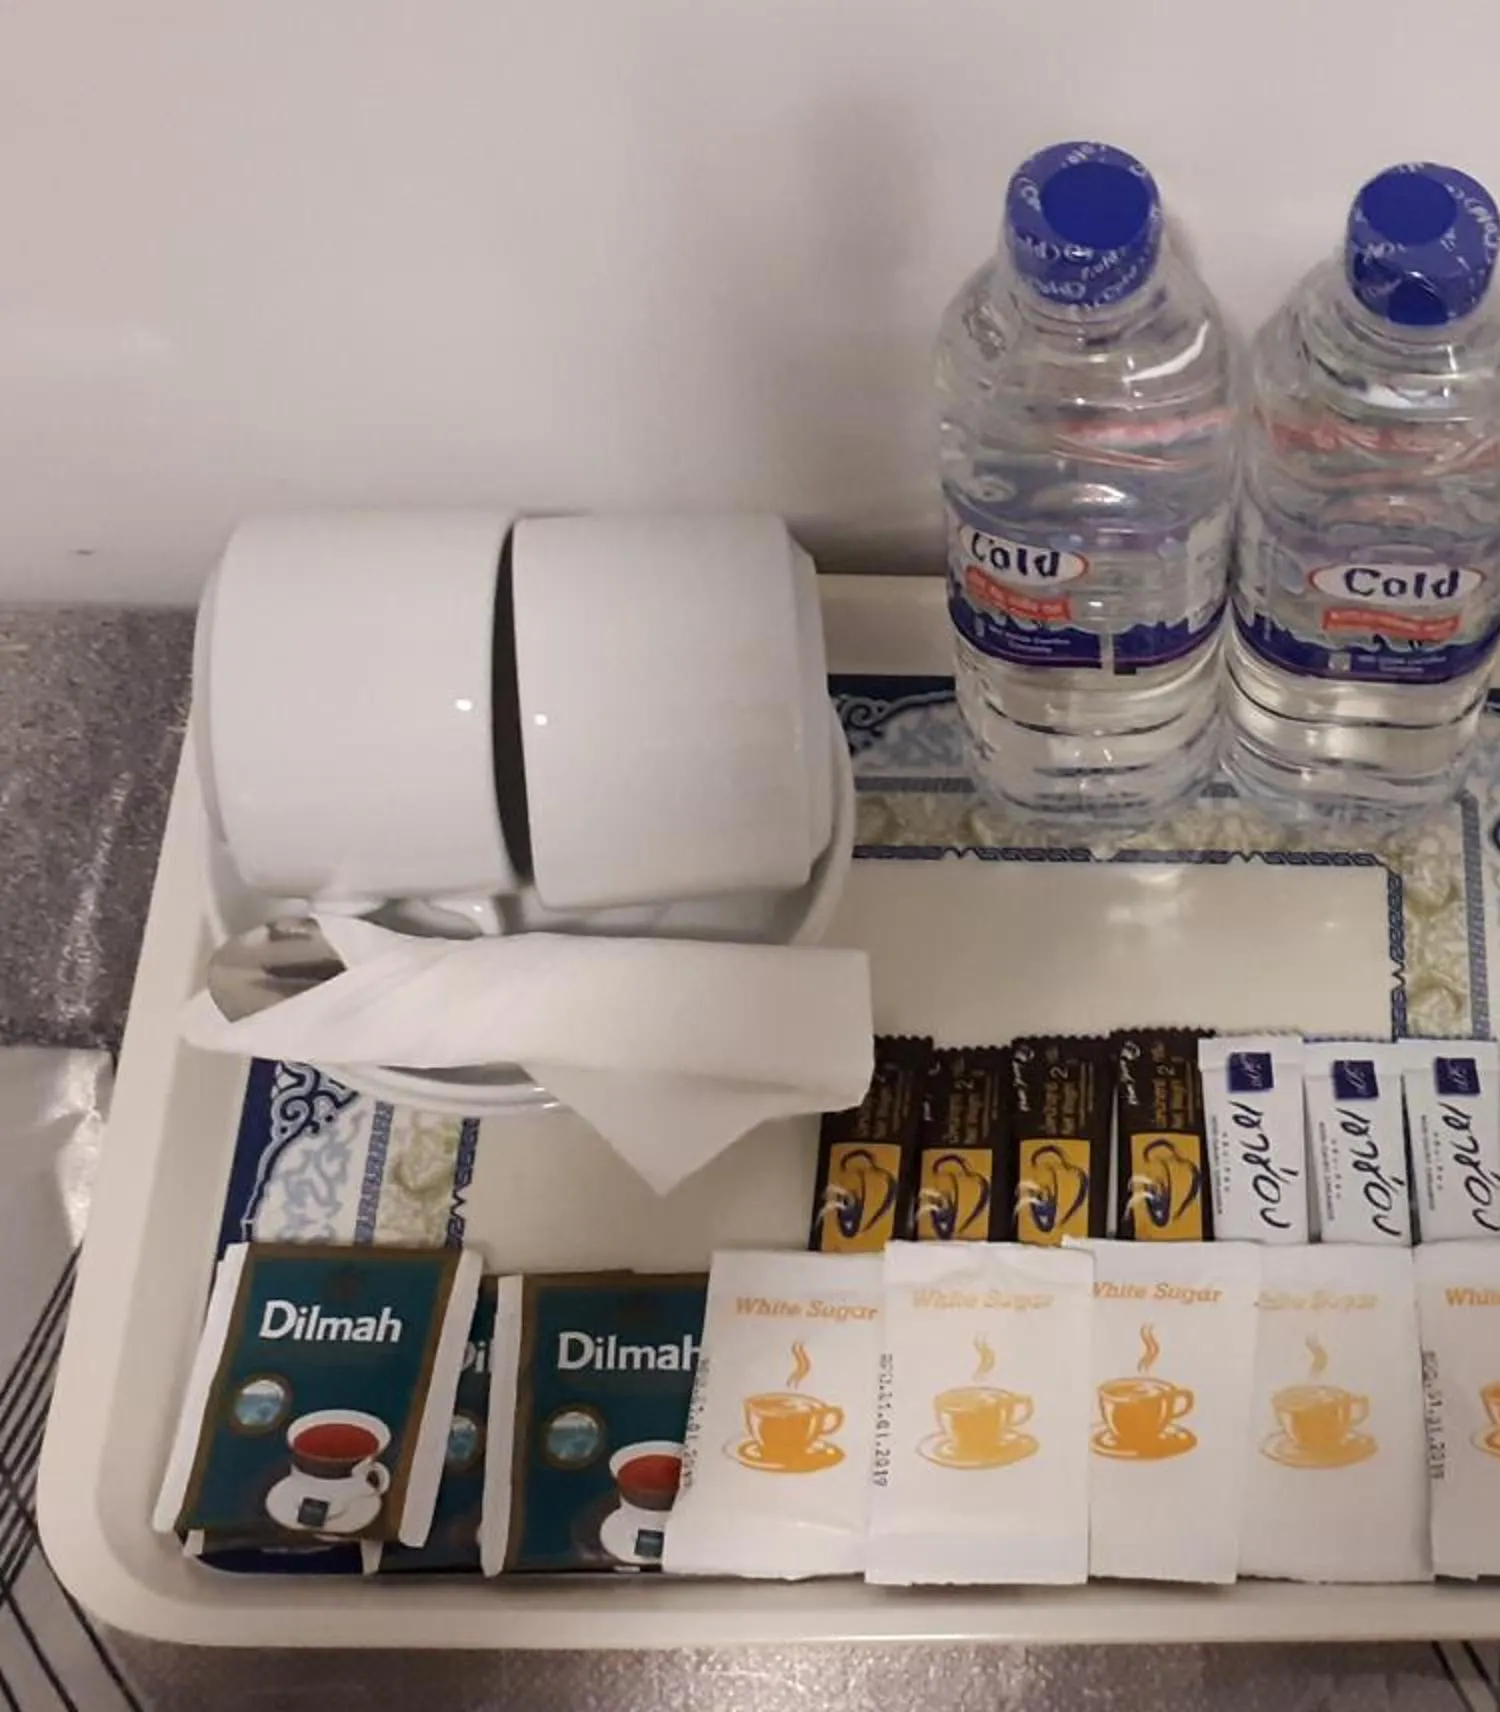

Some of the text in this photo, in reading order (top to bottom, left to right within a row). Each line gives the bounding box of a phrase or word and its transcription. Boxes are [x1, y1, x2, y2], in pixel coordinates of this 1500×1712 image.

[971, 532, 1061, 578] Cold
[1345, 567, 1460, 598] Cold
[1228, 1101, 1299, 1229] เขาช่อง
[1336, 1108, 1405, 1236] เขาช่อง
[736, 1297, 878, 1321] White Sugar
[1154, 1281, 1223, 1304] Sugar
[258, 1300, 403, 1342] Dilmah
